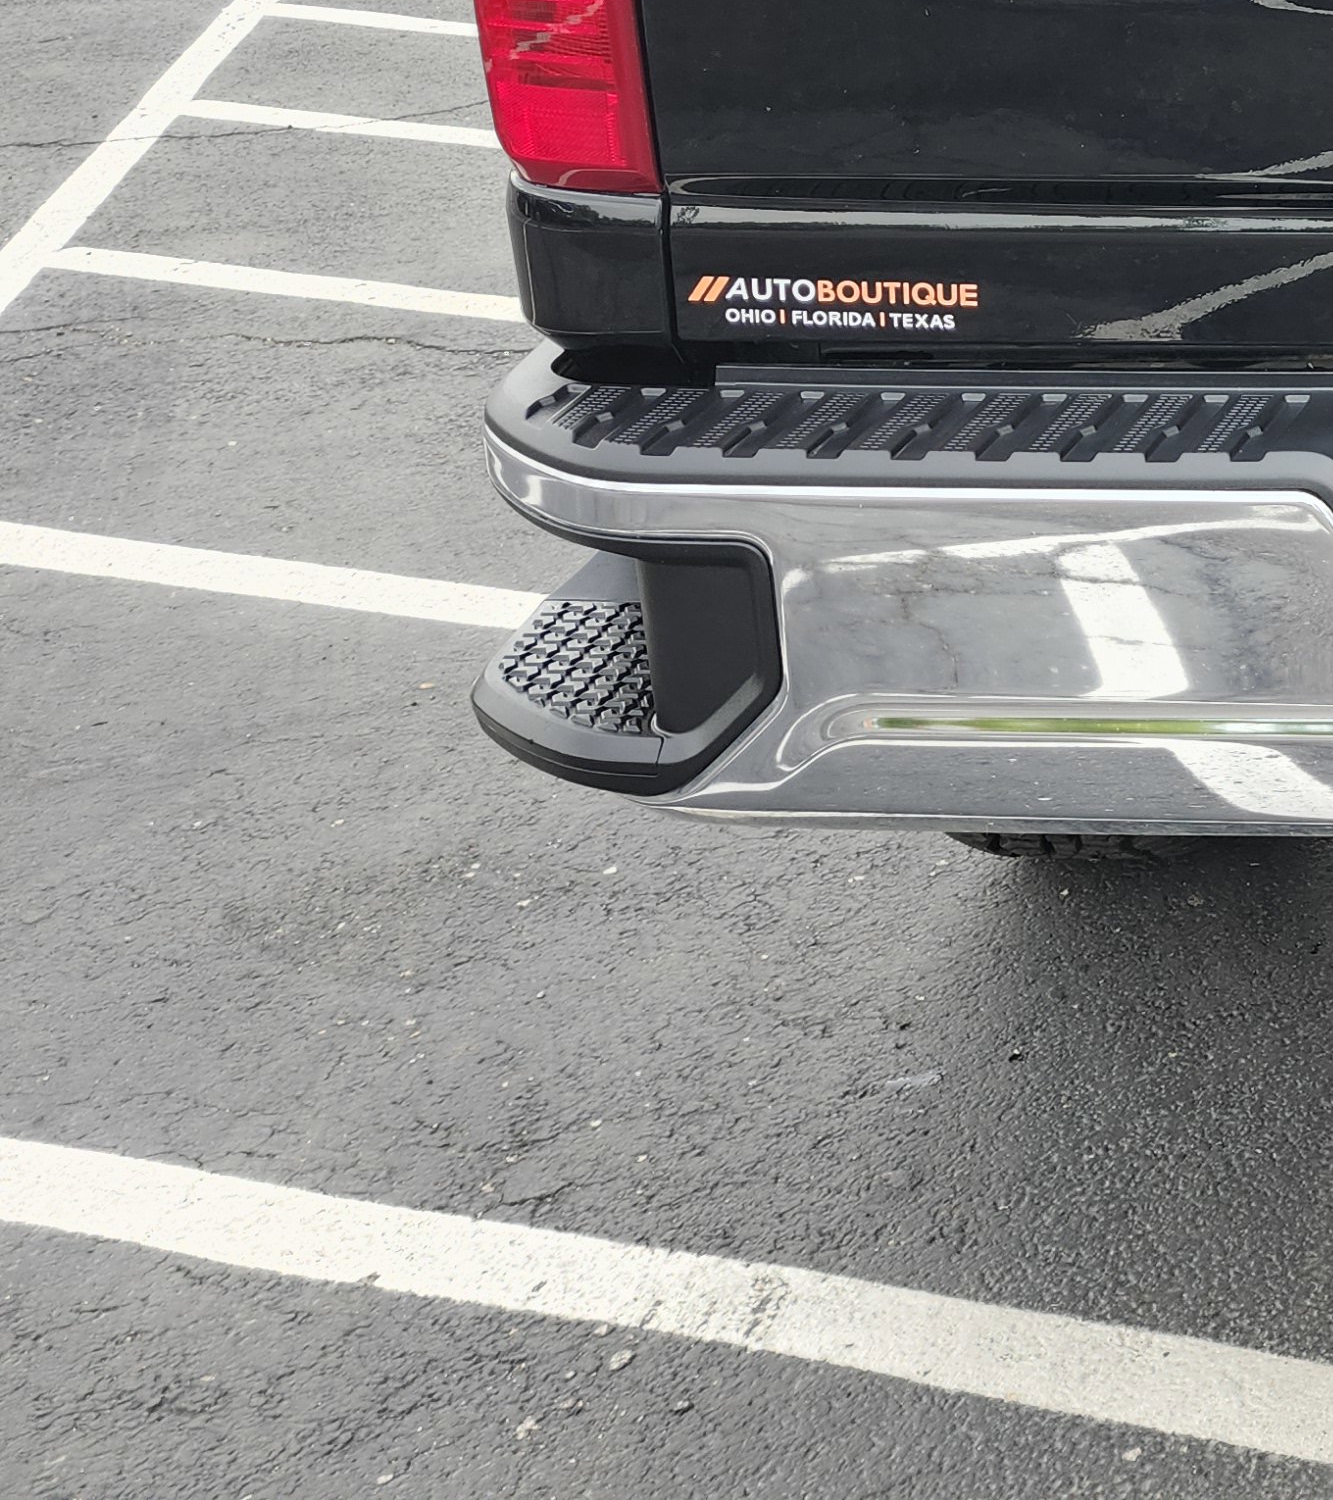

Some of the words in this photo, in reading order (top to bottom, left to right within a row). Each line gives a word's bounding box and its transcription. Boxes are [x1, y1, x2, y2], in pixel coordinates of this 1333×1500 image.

[724, 277, 979, 307] AUTOBOUTIQUE
[725, 308, 776, 324] OHIO
[791, 310, 876, 328] FLORIDA
[889, 312, 956, 329] TEXAS
